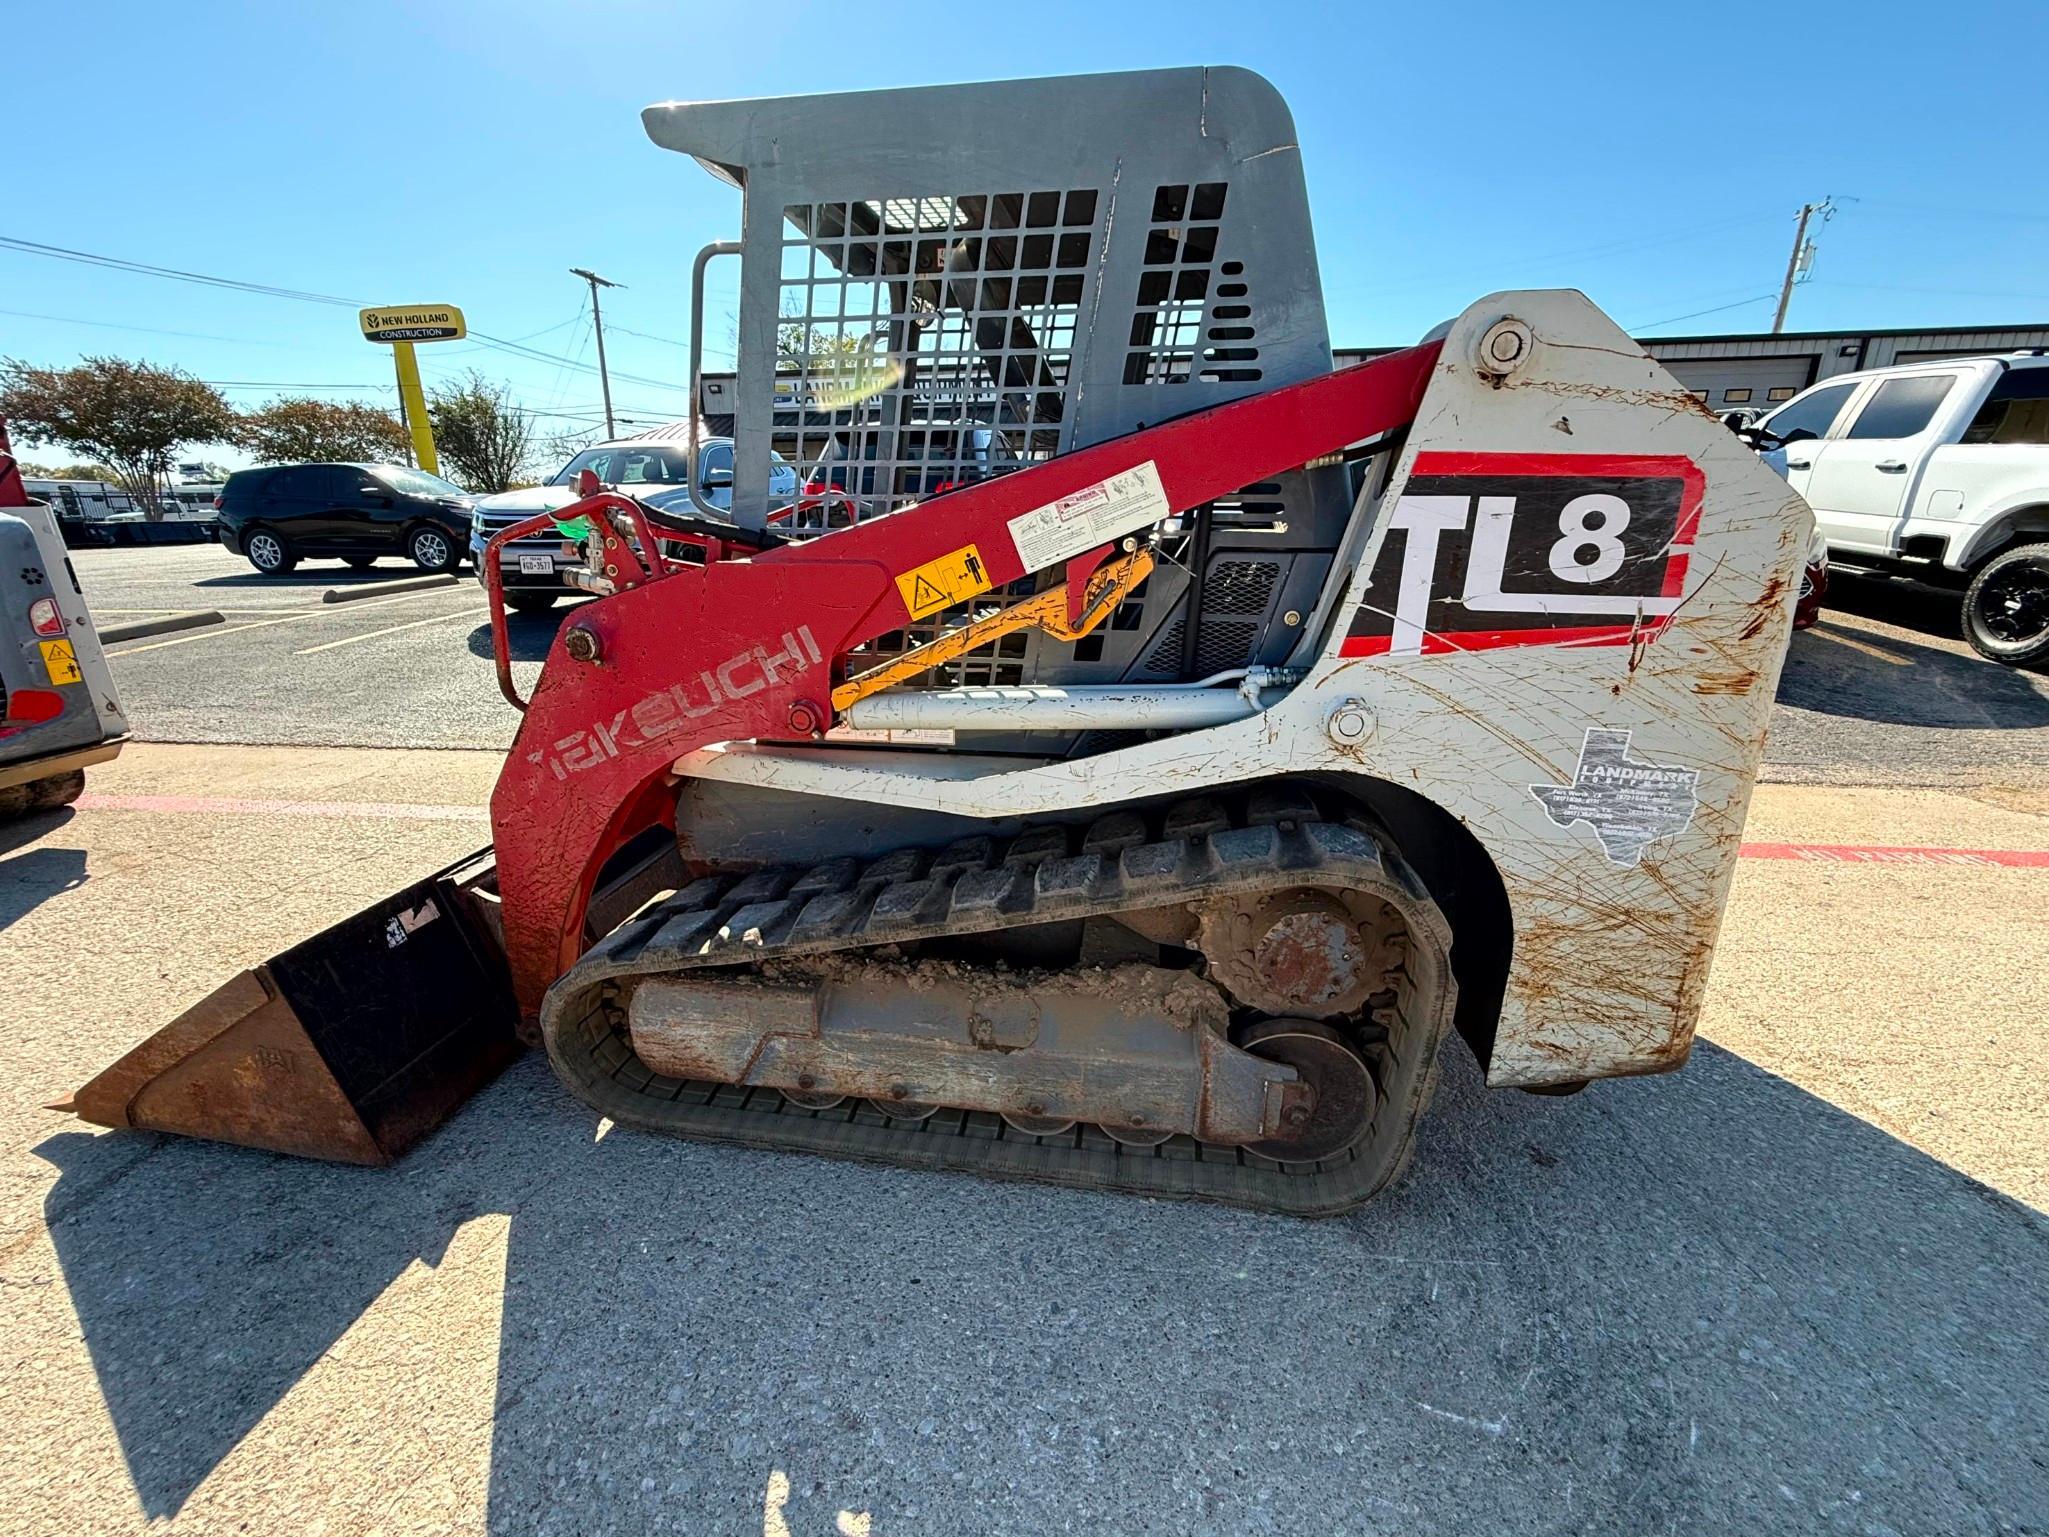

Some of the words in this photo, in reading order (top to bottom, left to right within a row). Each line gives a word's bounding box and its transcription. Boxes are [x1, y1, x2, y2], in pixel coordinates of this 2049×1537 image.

[381, 315, 403, 326] NEW
[405, 313, 449, 325] HOLLAND
[380, 328, 442, 339] CONSTRUCTION
[1388, 493, 1682, 657] TL8
[1581, 765, 1693, 783] LANDMARK
